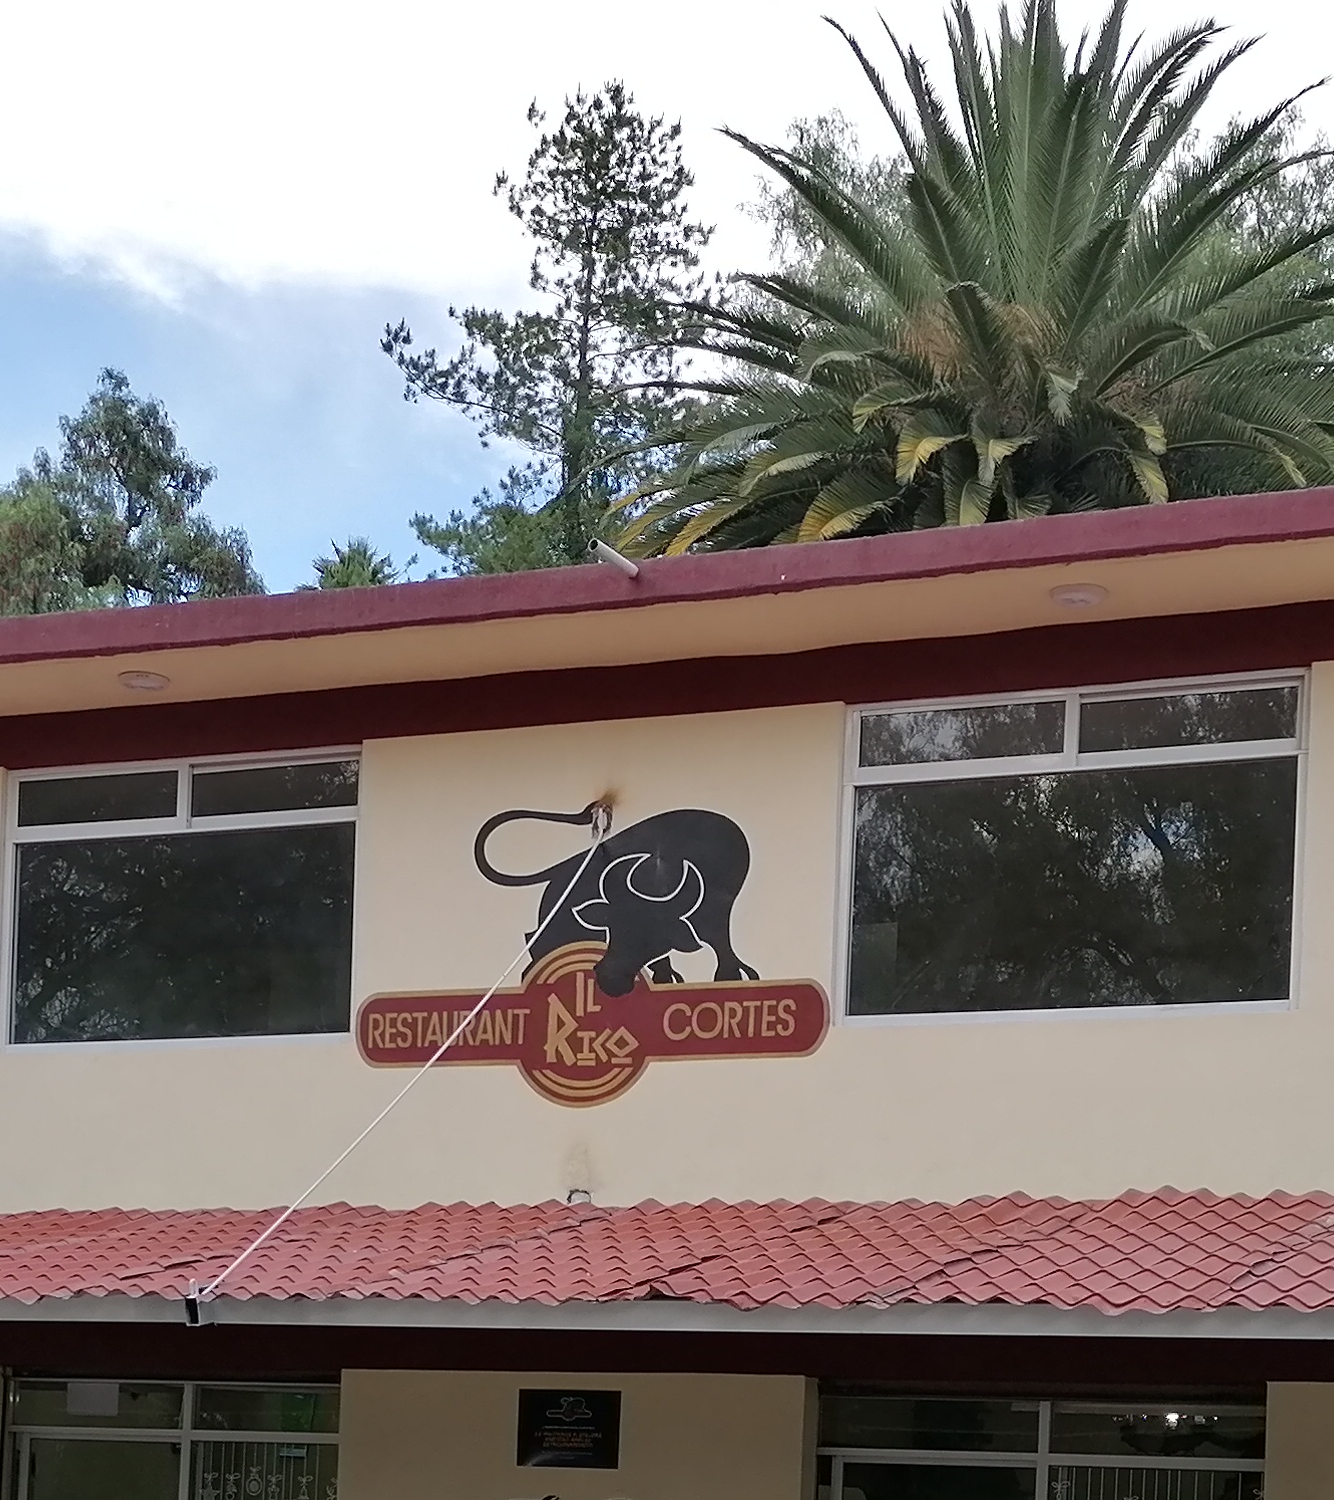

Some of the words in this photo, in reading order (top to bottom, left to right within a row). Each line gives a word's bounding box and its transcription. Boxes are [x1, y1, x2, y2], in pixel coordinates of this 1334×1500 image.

[576, 971, 601, 1017] IL
[367, 1008, 531, 1049] RESTAURANT
[662, 998, 796, 1042] CORTES
